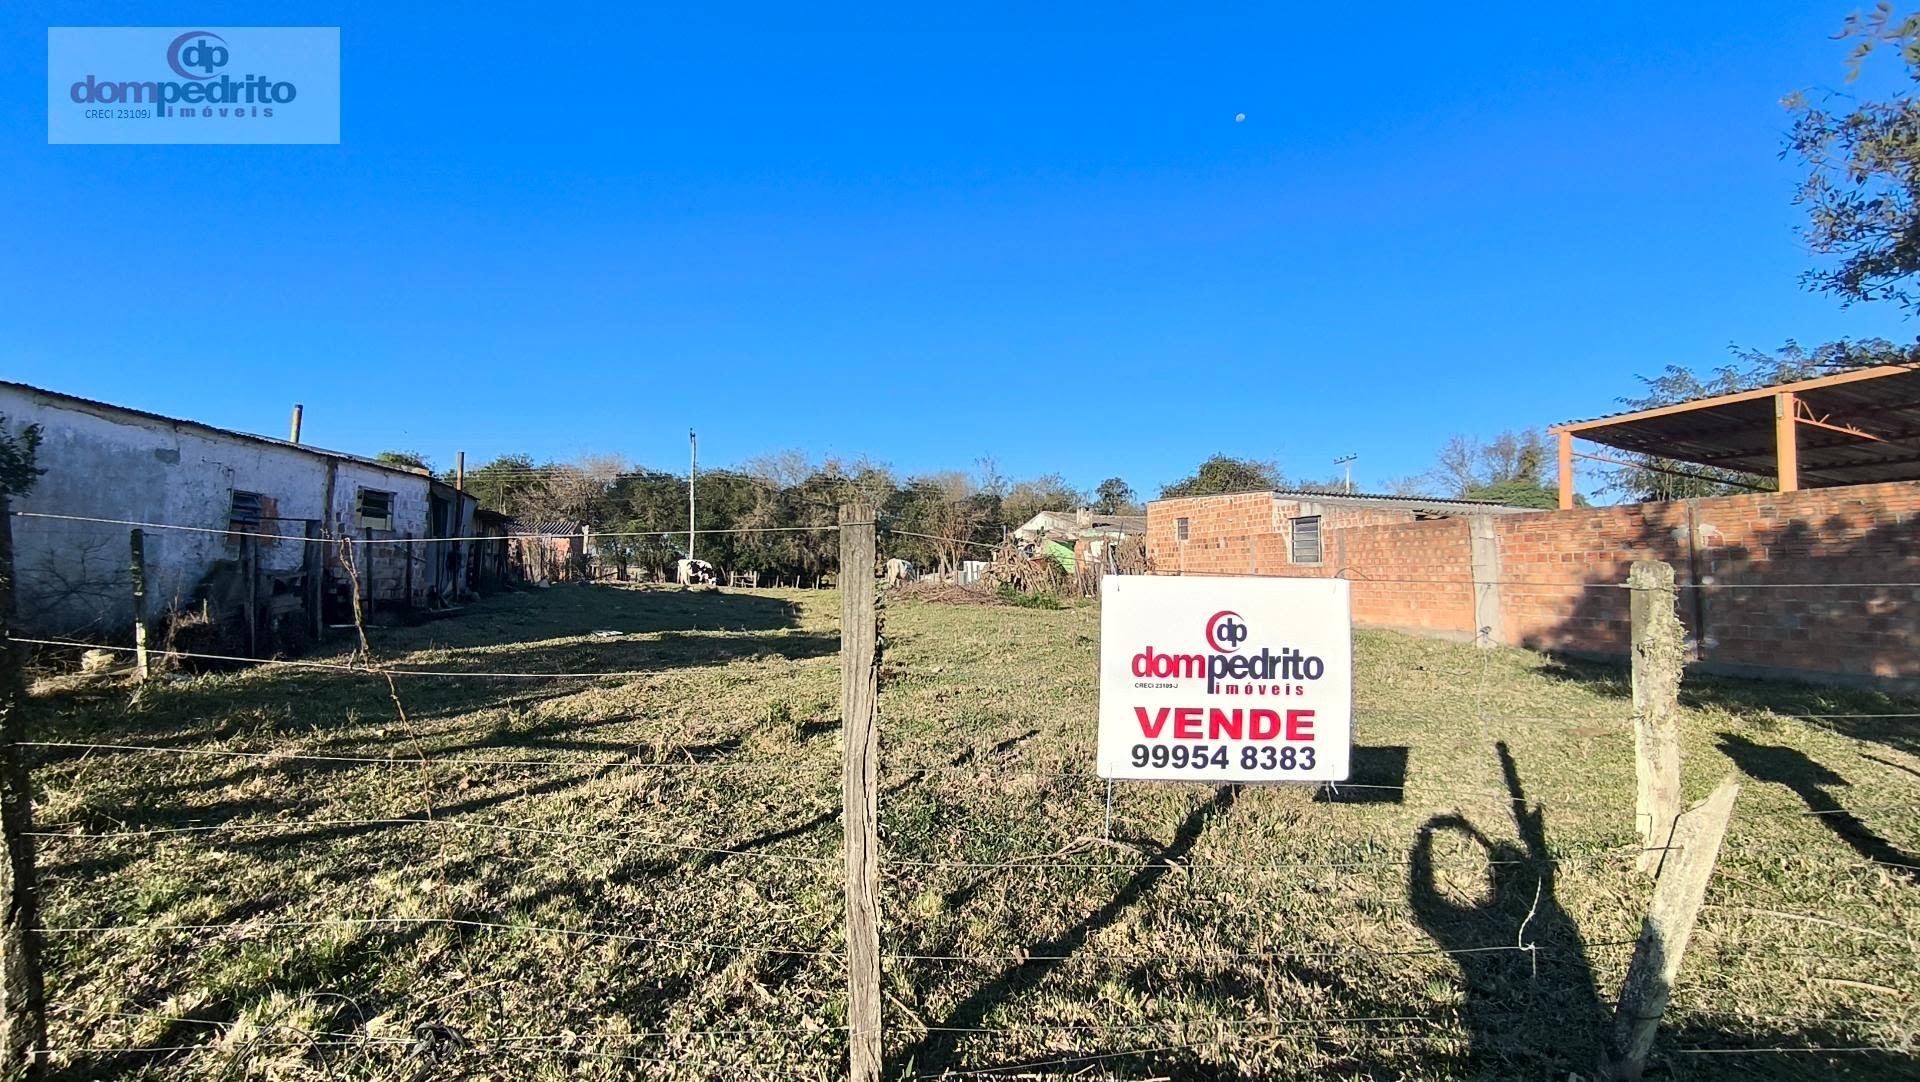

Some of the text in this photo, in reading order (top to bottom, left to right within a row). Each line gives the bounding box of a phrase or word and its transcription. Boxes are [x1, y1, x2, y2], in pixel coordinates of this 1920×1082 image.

[1216, 617, 1248, 648] dp
[1215, 681, 1304, 696] imóveis
[1133, 706, 1316, 741] VENDE
[1131, 744, 1316, 771] 99954 8383
